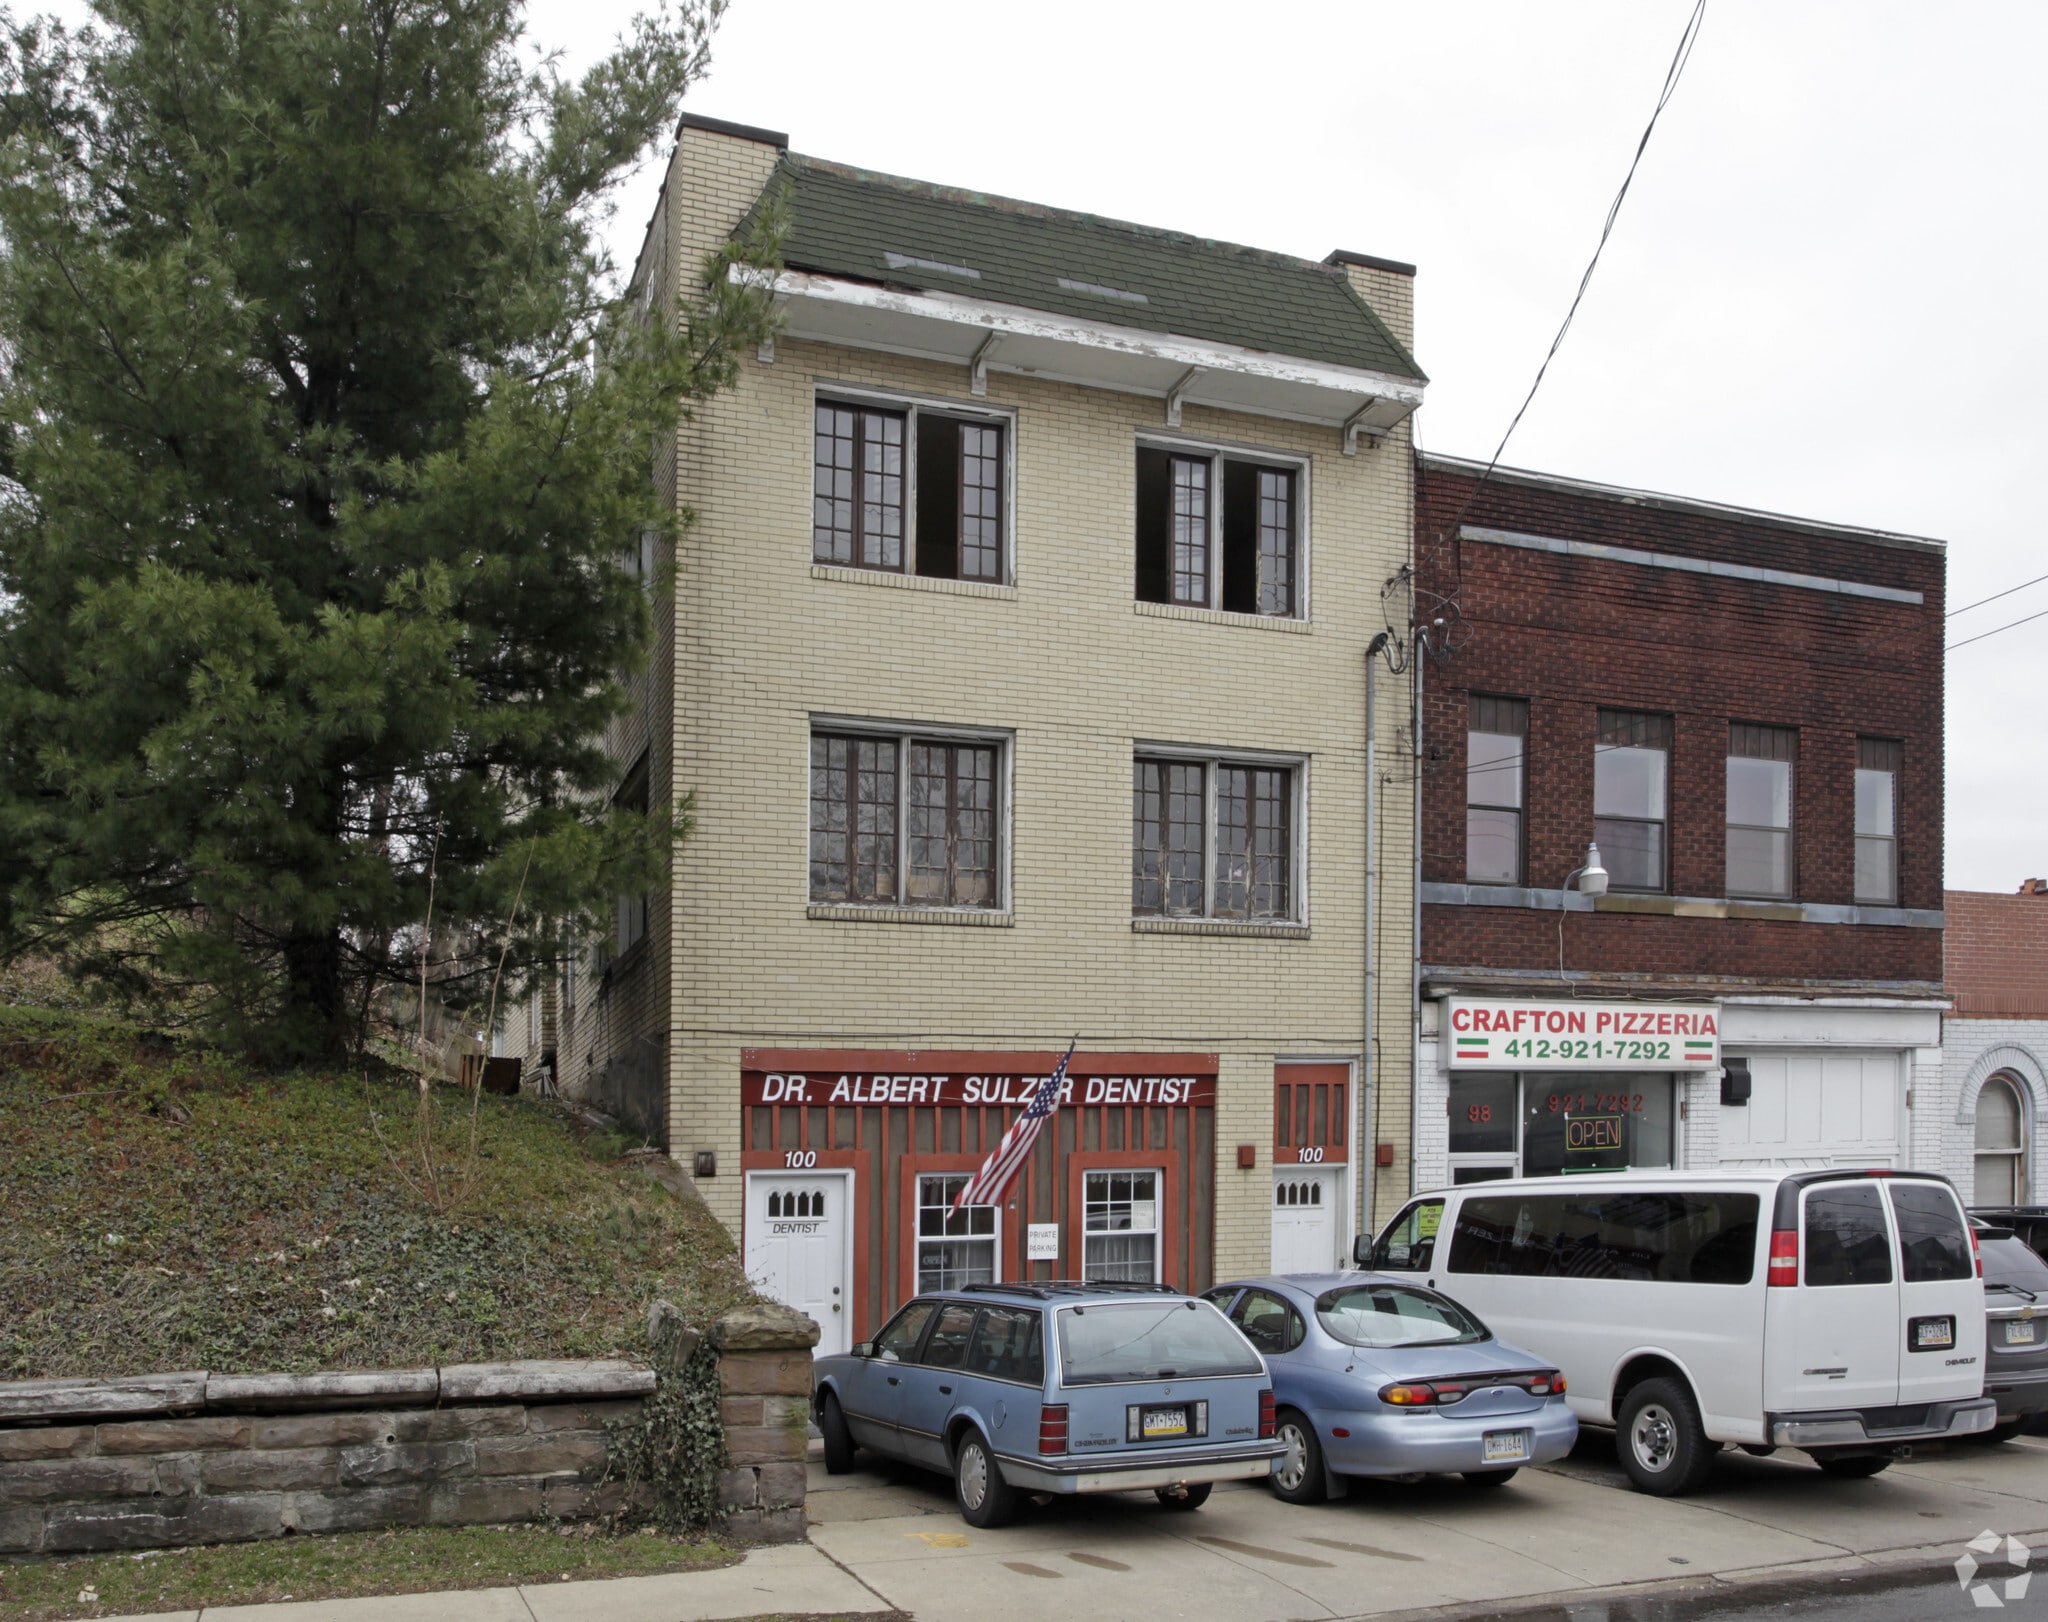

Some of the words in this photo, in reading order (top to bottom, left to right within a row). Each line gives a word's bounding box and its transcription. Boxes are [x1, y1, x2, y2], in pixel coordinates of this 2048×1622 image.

[1452, 1009, 1586, 1034] CRAFTON
[1596, 1012, 1717, 1036] PIZZERIA
[1505, 1039, 1671, 1060] 412-921-7292
[762, 1074, 812, 1102] DR.
[829, 1075, 949, 1103] ALBERT
[962, 1076, 1075, 1103] SULZR
[1085, 1077, 1197, 1103] DENTIST
[1548, 1094, 1587, 1112] 921
[1595, 1094, 1644, 1112] 7292
[1468, 1104, 1491, 1122] 98
[1568, 1120, 1620, 1146] OPEN
[784, 1150, 817, 1168] 100
[1298, 1147, 1324, 1163] 100
[772, 1223, 819, 1234] DENTIST
[1029, 1231, 1057, 1239] PRIVATE
[1029, 1244, 1057, 1252] PARKING
